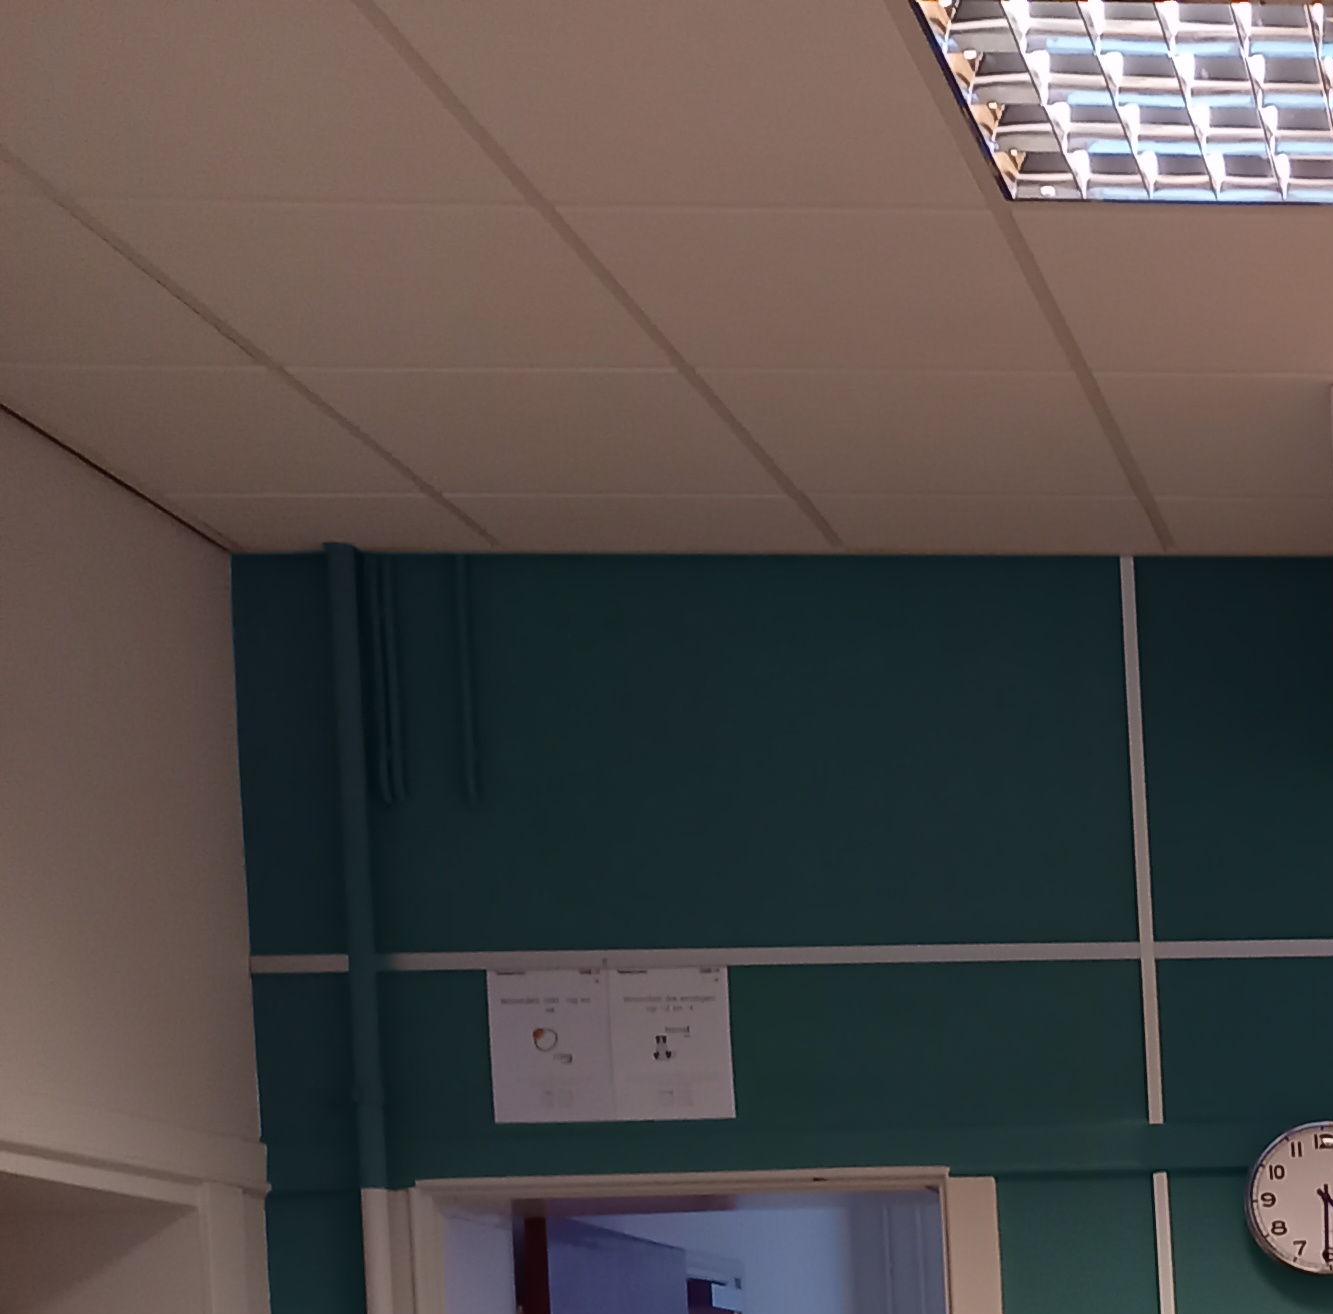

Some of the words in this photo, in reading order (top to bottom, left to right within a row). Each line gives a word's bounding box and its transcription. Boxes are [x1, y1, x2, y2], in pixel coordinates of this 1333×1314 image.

[1291, 1141, 1302, 1157] 11
[1314, 1134, 1333, 1149] 12
[1269, 1164, 1285, 1180] 10
[1261, 1192, 1276, 1207] 9
[1271, 1221, 1287, 1235] 8
[1293, 1241, 1306, 1256] 7
